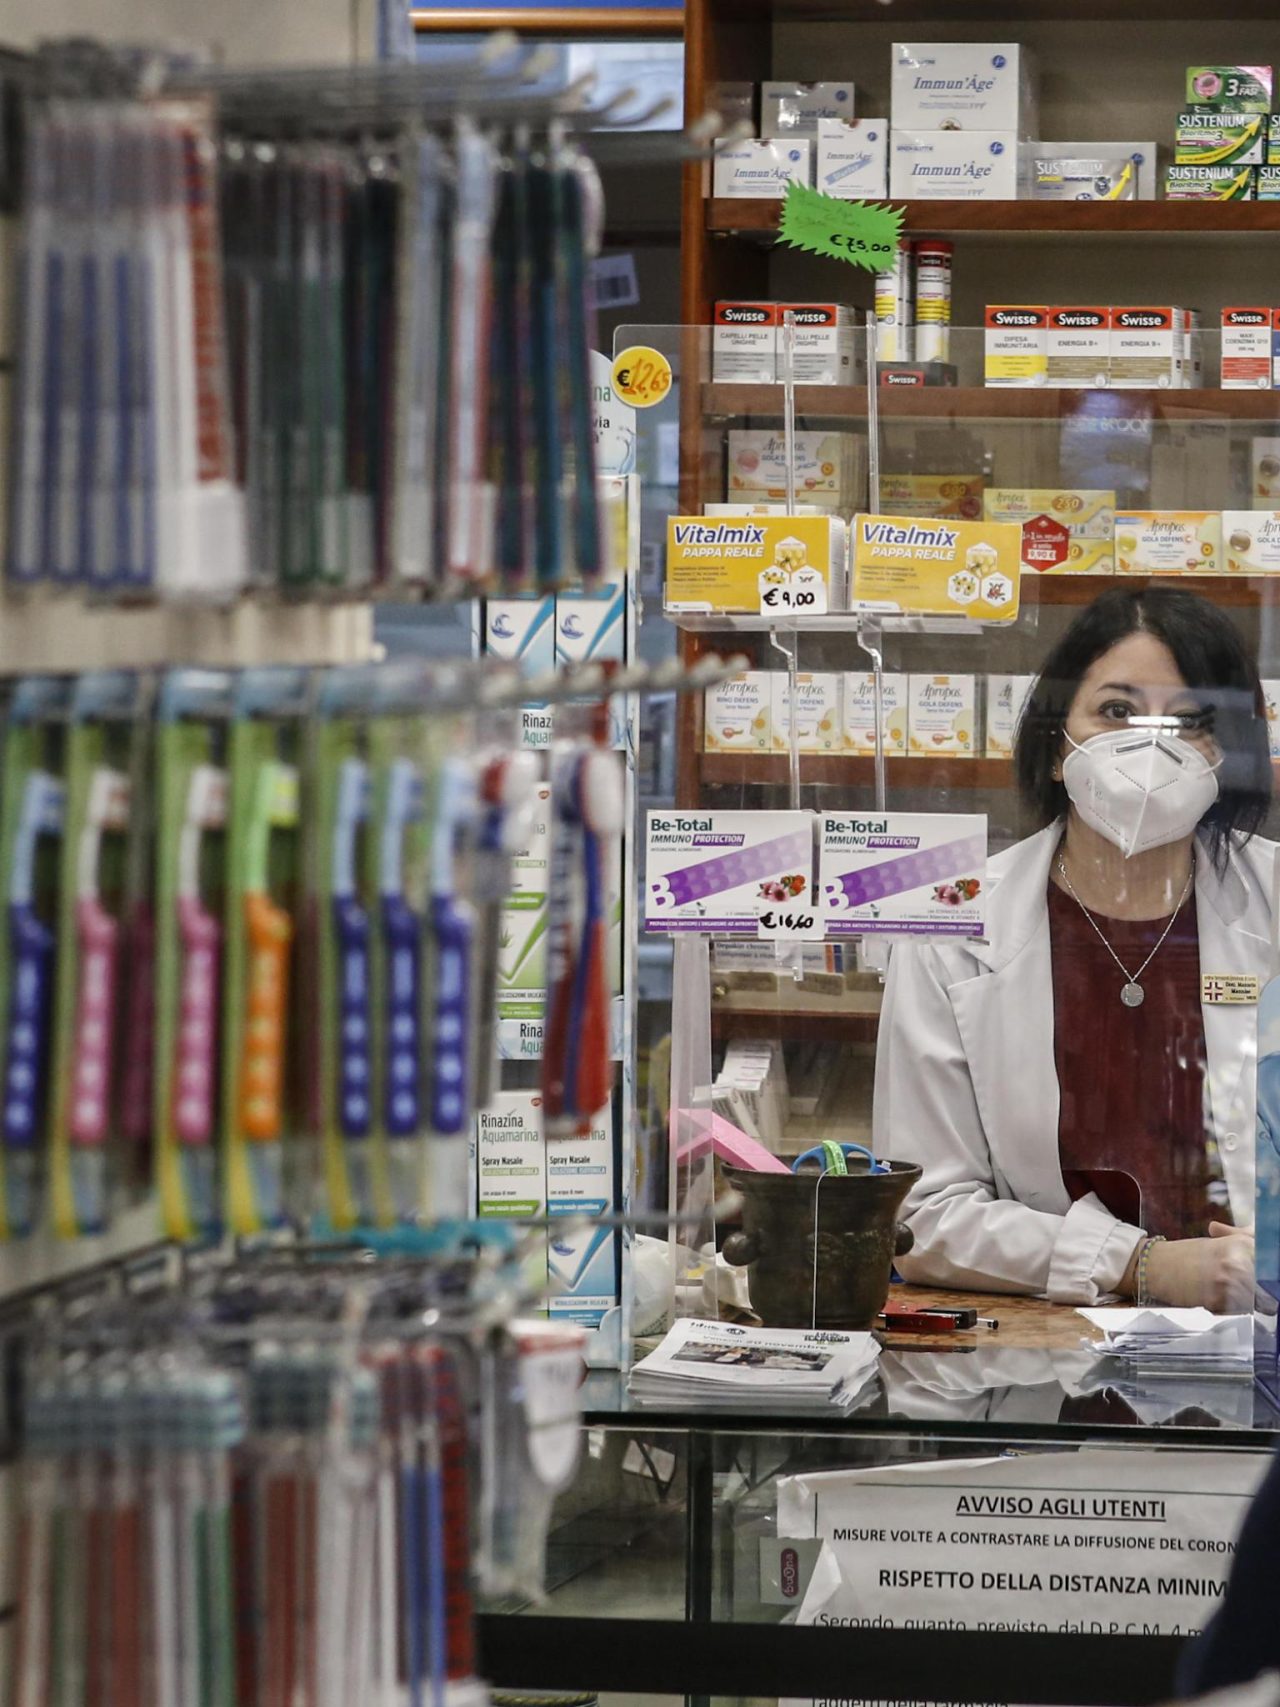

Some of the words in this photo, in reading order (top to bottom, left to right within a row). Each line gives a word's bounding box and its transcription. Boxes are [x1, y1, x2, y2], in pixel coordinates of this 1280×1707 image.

[1179, 115, 1244, 127] SUSTENIUM
[1169, 167, 1234, 179] SUSTENIUM
[725, 310, 765, 322] Swisse
[996, 313, 1037, 325] Swisse
[1058, 314, 1099, 325] Swisse
[1121, 314, 1162, 325] Swisse
[1231, 314, 1263, 324] Swisse
[674, 525, 764, 544] Vitalmix
[862, 524, 956, 546] Vitalmix
[682, 547, 721, 558] PAPPA
[726, 546, 764, 558] REALE
[871, 547, 911, 558] PAPPA
[915, 549, 954, 561] REALE
[763, 589, 778, 607] €
[651, 818, 712, 831] Be-Total
[825, 820, 887, 833] Be-Total
[651, 834, 691, 843] IMMUNO
[694, 834, 743, 842] PROTECTION
[825, 836, 866, 845] IMMUNO
[869, 837, 918, 845] PROTECTION
[760, 912, 777, 928] €
[481, 1110, 523, 1128] Rinazina
[482, 1129, 538, 1144] Aquamarina
[482, 1157, 500, 1166] Spray
[550, 1156, 567, 1165] Spray
[569, 1156, 590, 1164] Nasale
[956, 1495, 1034, 1515] AVVISO
[1040, 1498, 1087, 1516] AGLI
[1093, 1499, 1166, 1518] UTENTI
[833, 1529, 886, 1542] MISURE
[890, 1530, 932, 1544] VOLTE
[937, 1531, 947, 1544] A
[950, 1532, 1050, 1547] CONTRASTARE
[1054, 1534, 1070, 1547] LA
[1074, 1534, 1155, 1550] DIFFUSIONE
[1159, 1537, 1184, 1551] DEL
[879, 1569, 975, 1590] RISPETTO
[981, 1572, 1043, 1591] DELLA
[1049, 1574, 1151, 1595] DISTANZA
